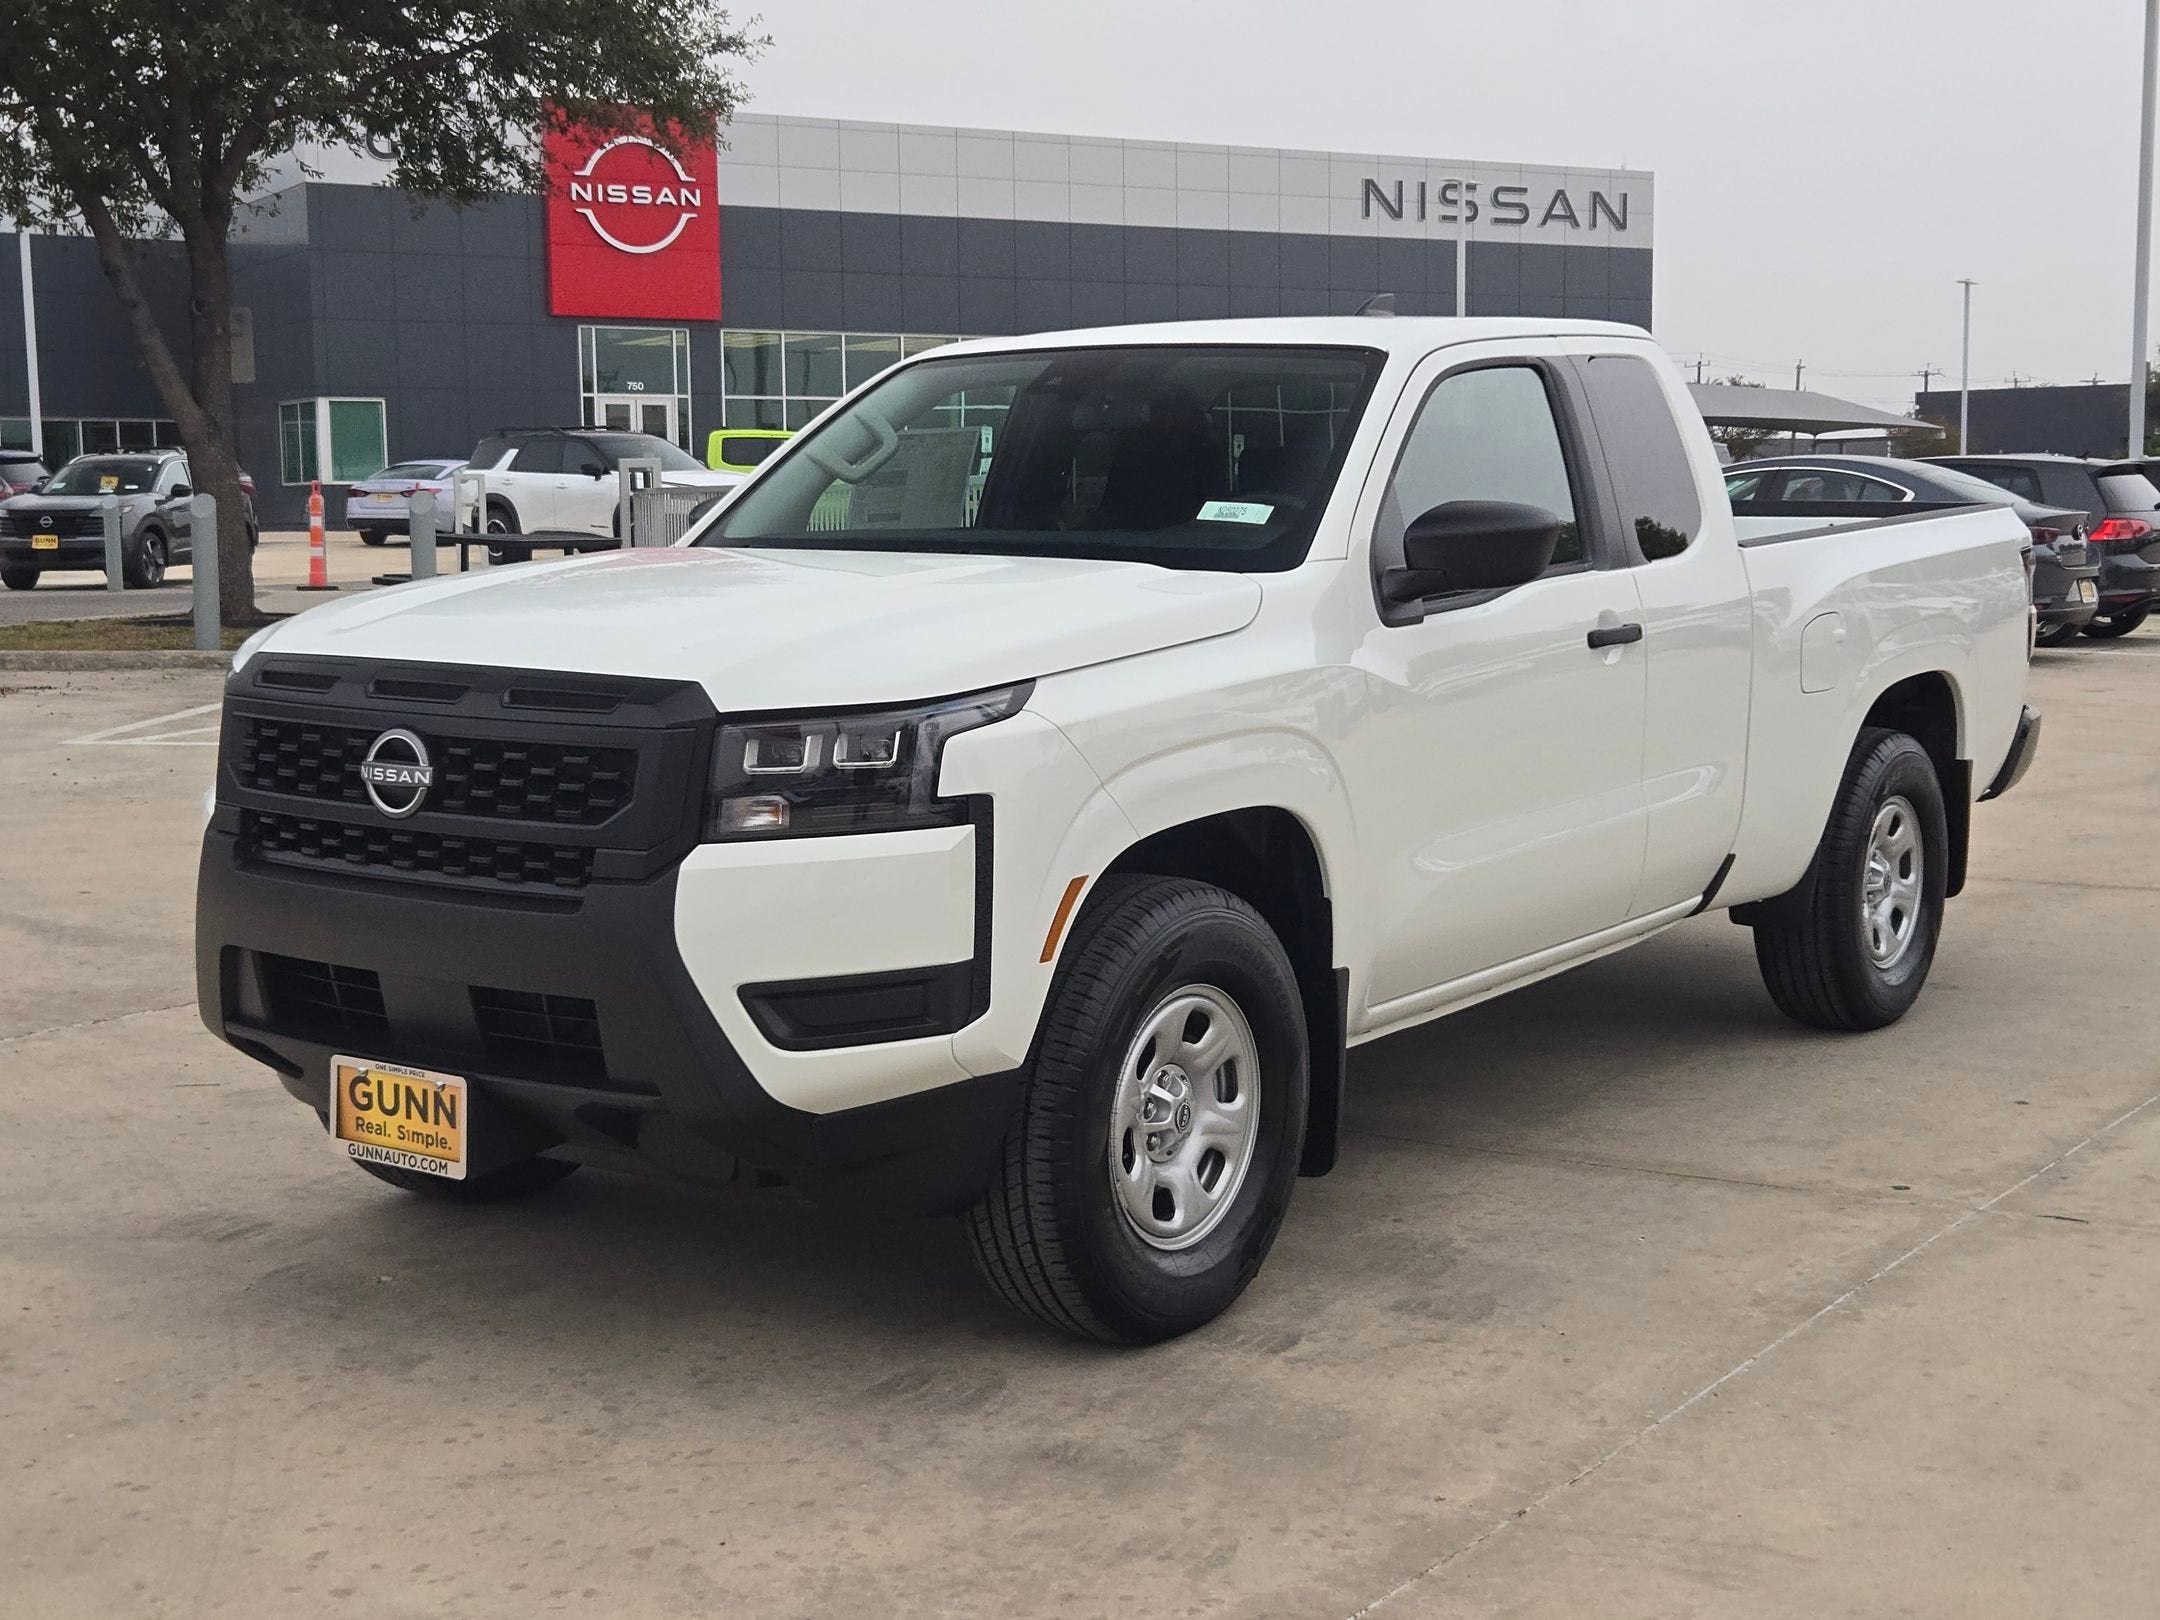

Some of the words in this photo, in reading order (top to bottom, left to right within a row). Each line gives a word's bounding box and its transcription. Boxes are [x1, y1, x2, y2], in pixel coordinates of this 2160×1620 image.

[570, 182, 701, 207] NISSAN
[1362, 177, 1628, 231] NISSAN
[626, 381, 645, 391] 750
[361, 765, 430, 784] NISSAN
[375, 1063, 387, 1071] ONE
[388, 1066, 408, 1075] SIMPLE
[408, 1070, 426, 1078] PRICE
[349, 1074, 457, 1129] GUNN
[355, 1116, 391, 1138] Real.
[347, 1143, 448, 1175] GUNNAUTO.COM
